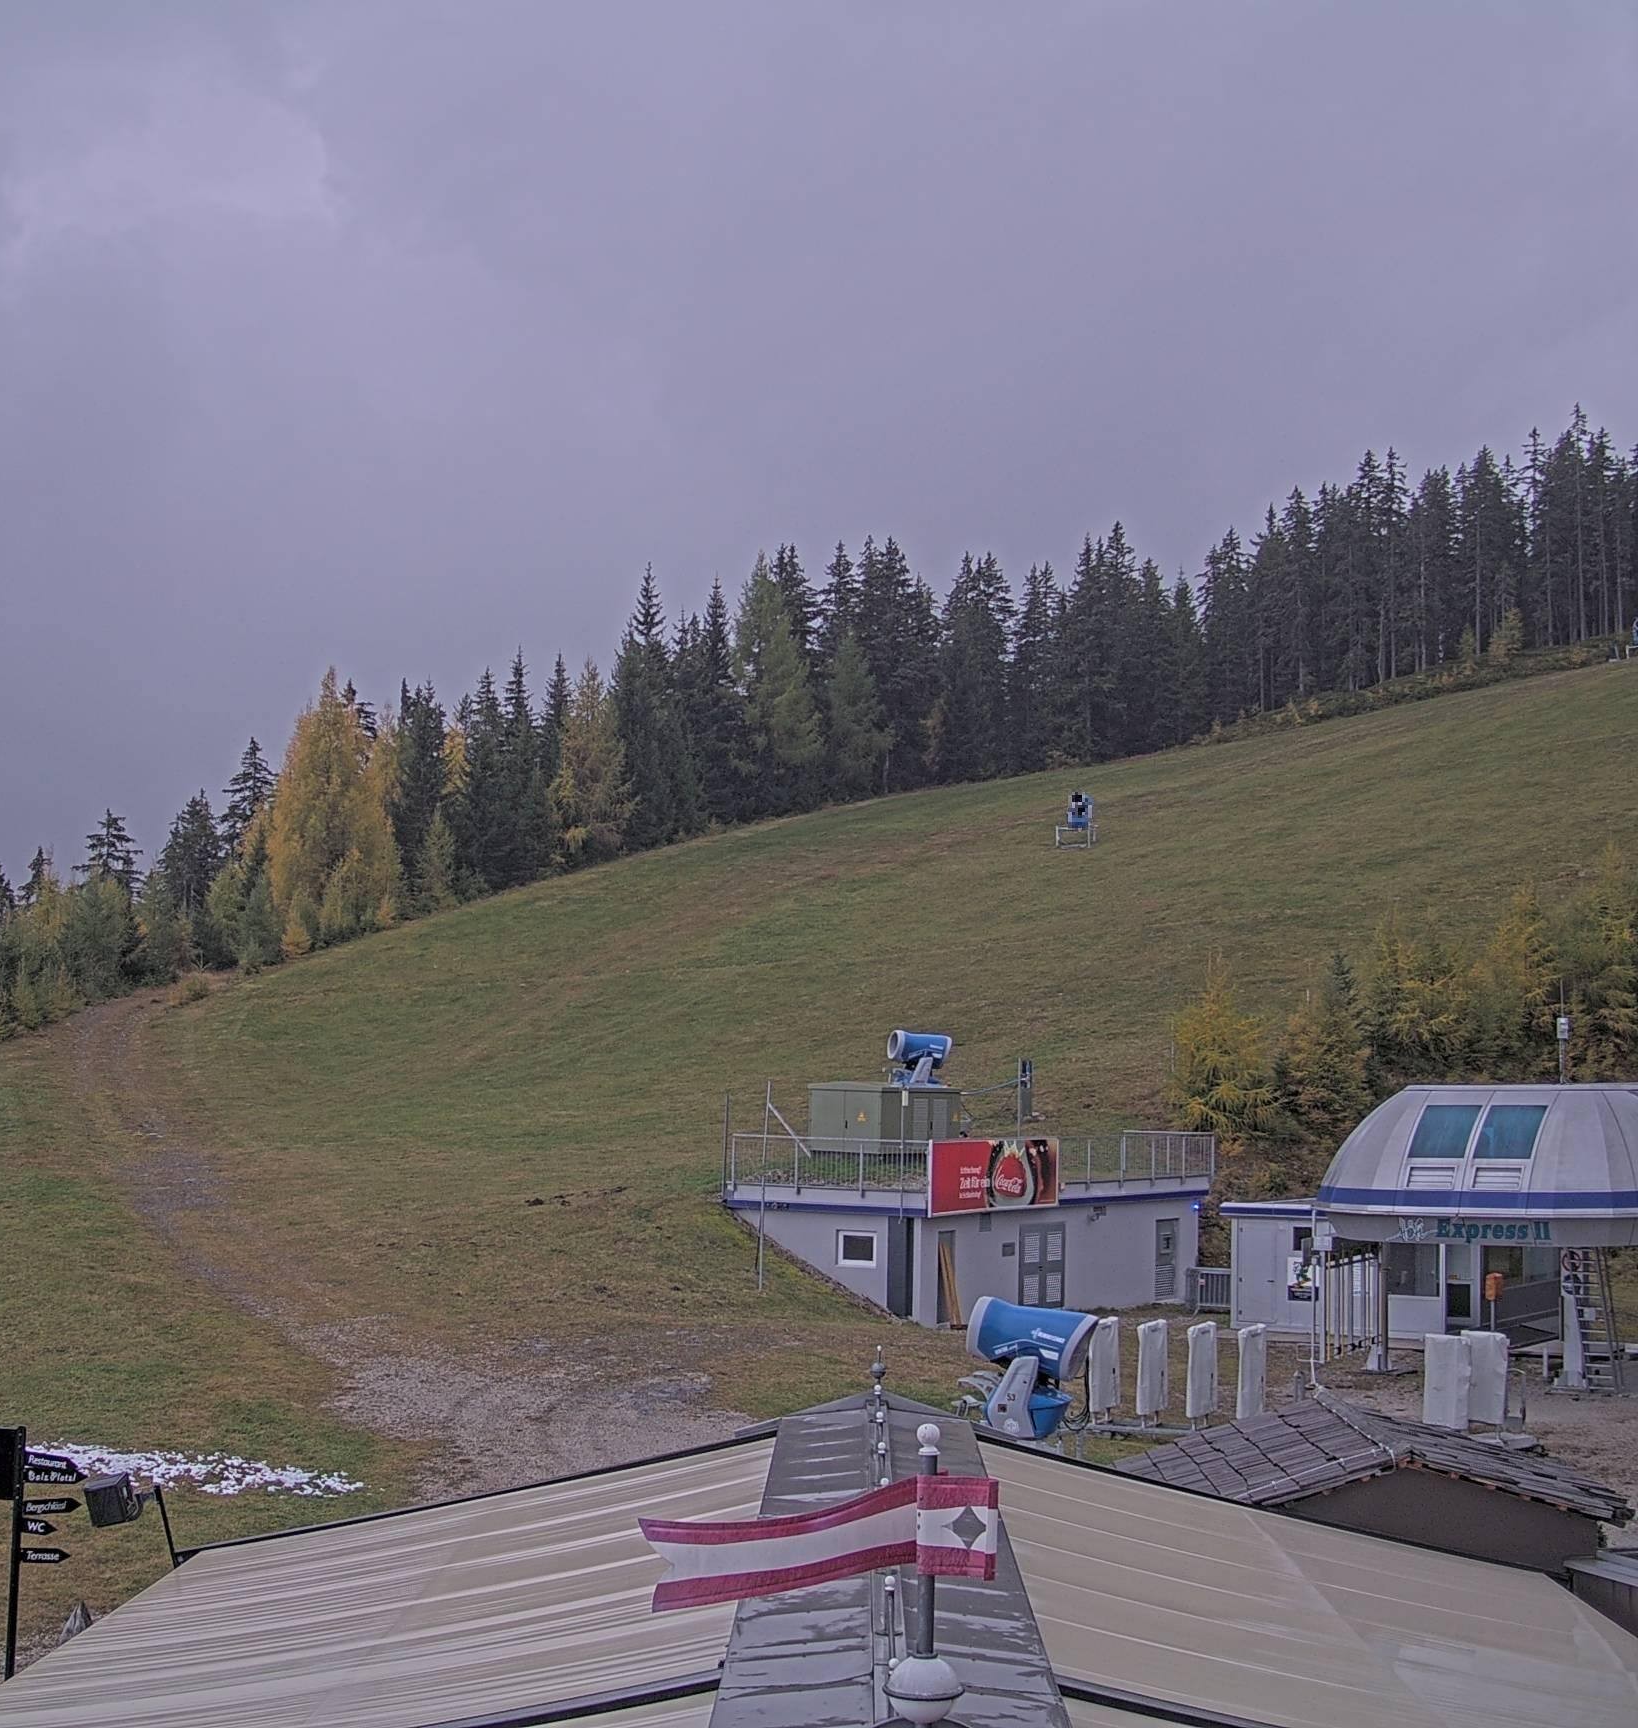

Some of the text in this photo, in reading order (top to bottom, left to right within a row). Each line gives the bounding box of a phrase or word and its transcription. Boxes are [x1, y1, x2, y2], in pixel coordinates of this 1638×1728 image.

[1436, 1219, 1529, 1244] Express
[1006, 1393, 1016, 1402] 53
[27, 1454, 68, 1470] Restaurant
[27, 1521, 46, 1532] WC
[26, 1550, 60, 1561] Terrasse
